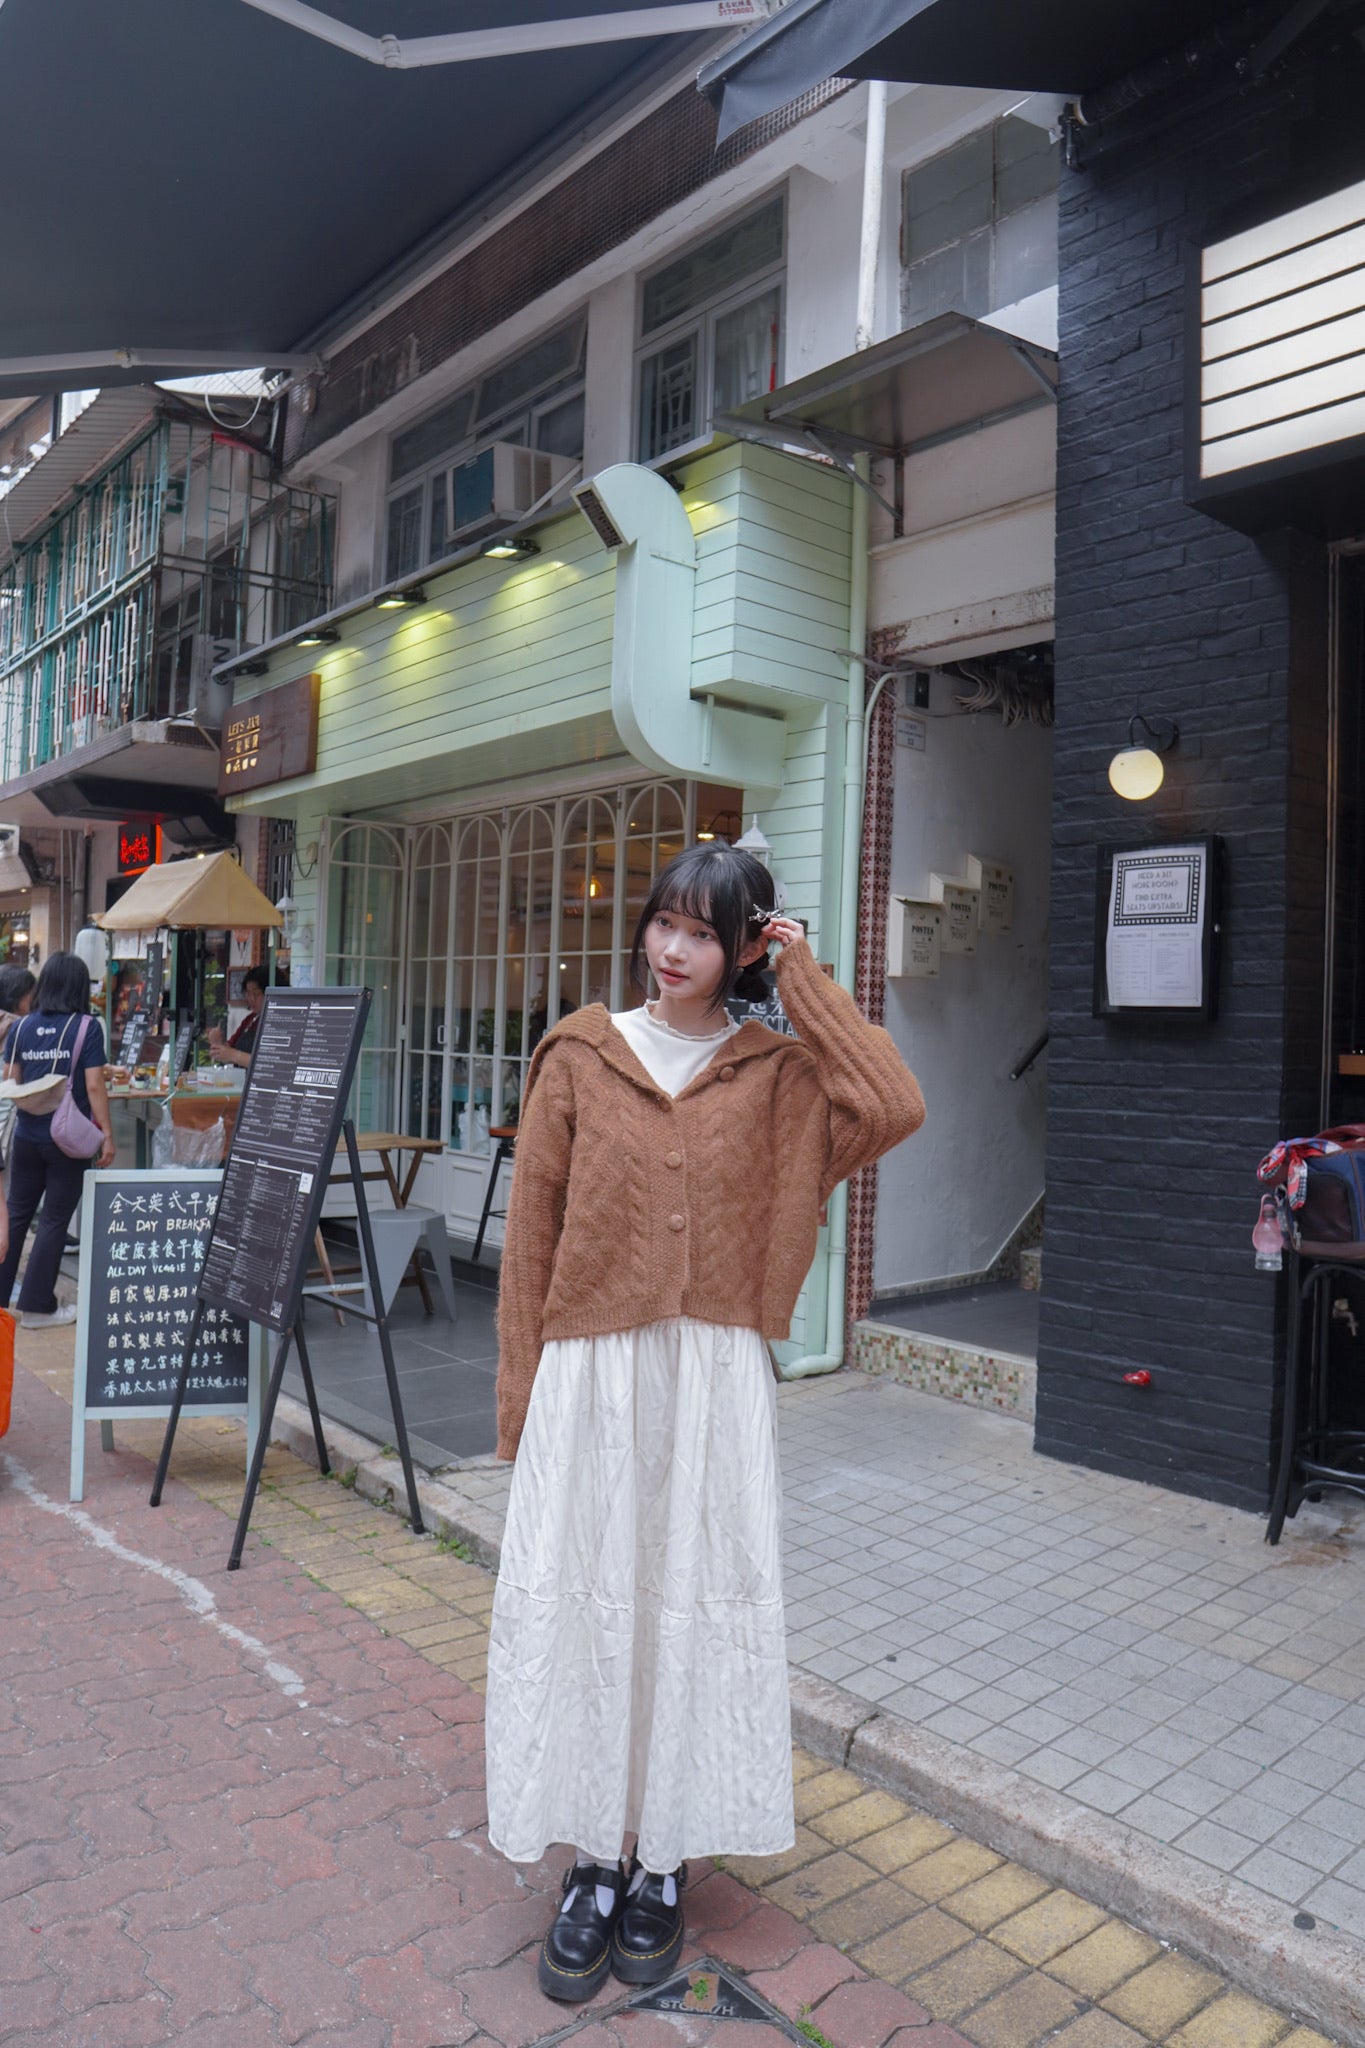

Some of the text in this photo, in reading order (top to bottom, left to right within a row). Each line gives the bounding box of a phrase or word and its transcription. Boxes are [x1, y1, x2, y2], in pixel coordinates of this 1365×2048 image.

[22, 1048, 70, 1060] education
[107, 1220, 128, 1234] ALL
[136, 1220, 158, 1232] DAY
[107, 1265, 125, 1278] ALL
[128, 1265, 147, 1277] DAY
